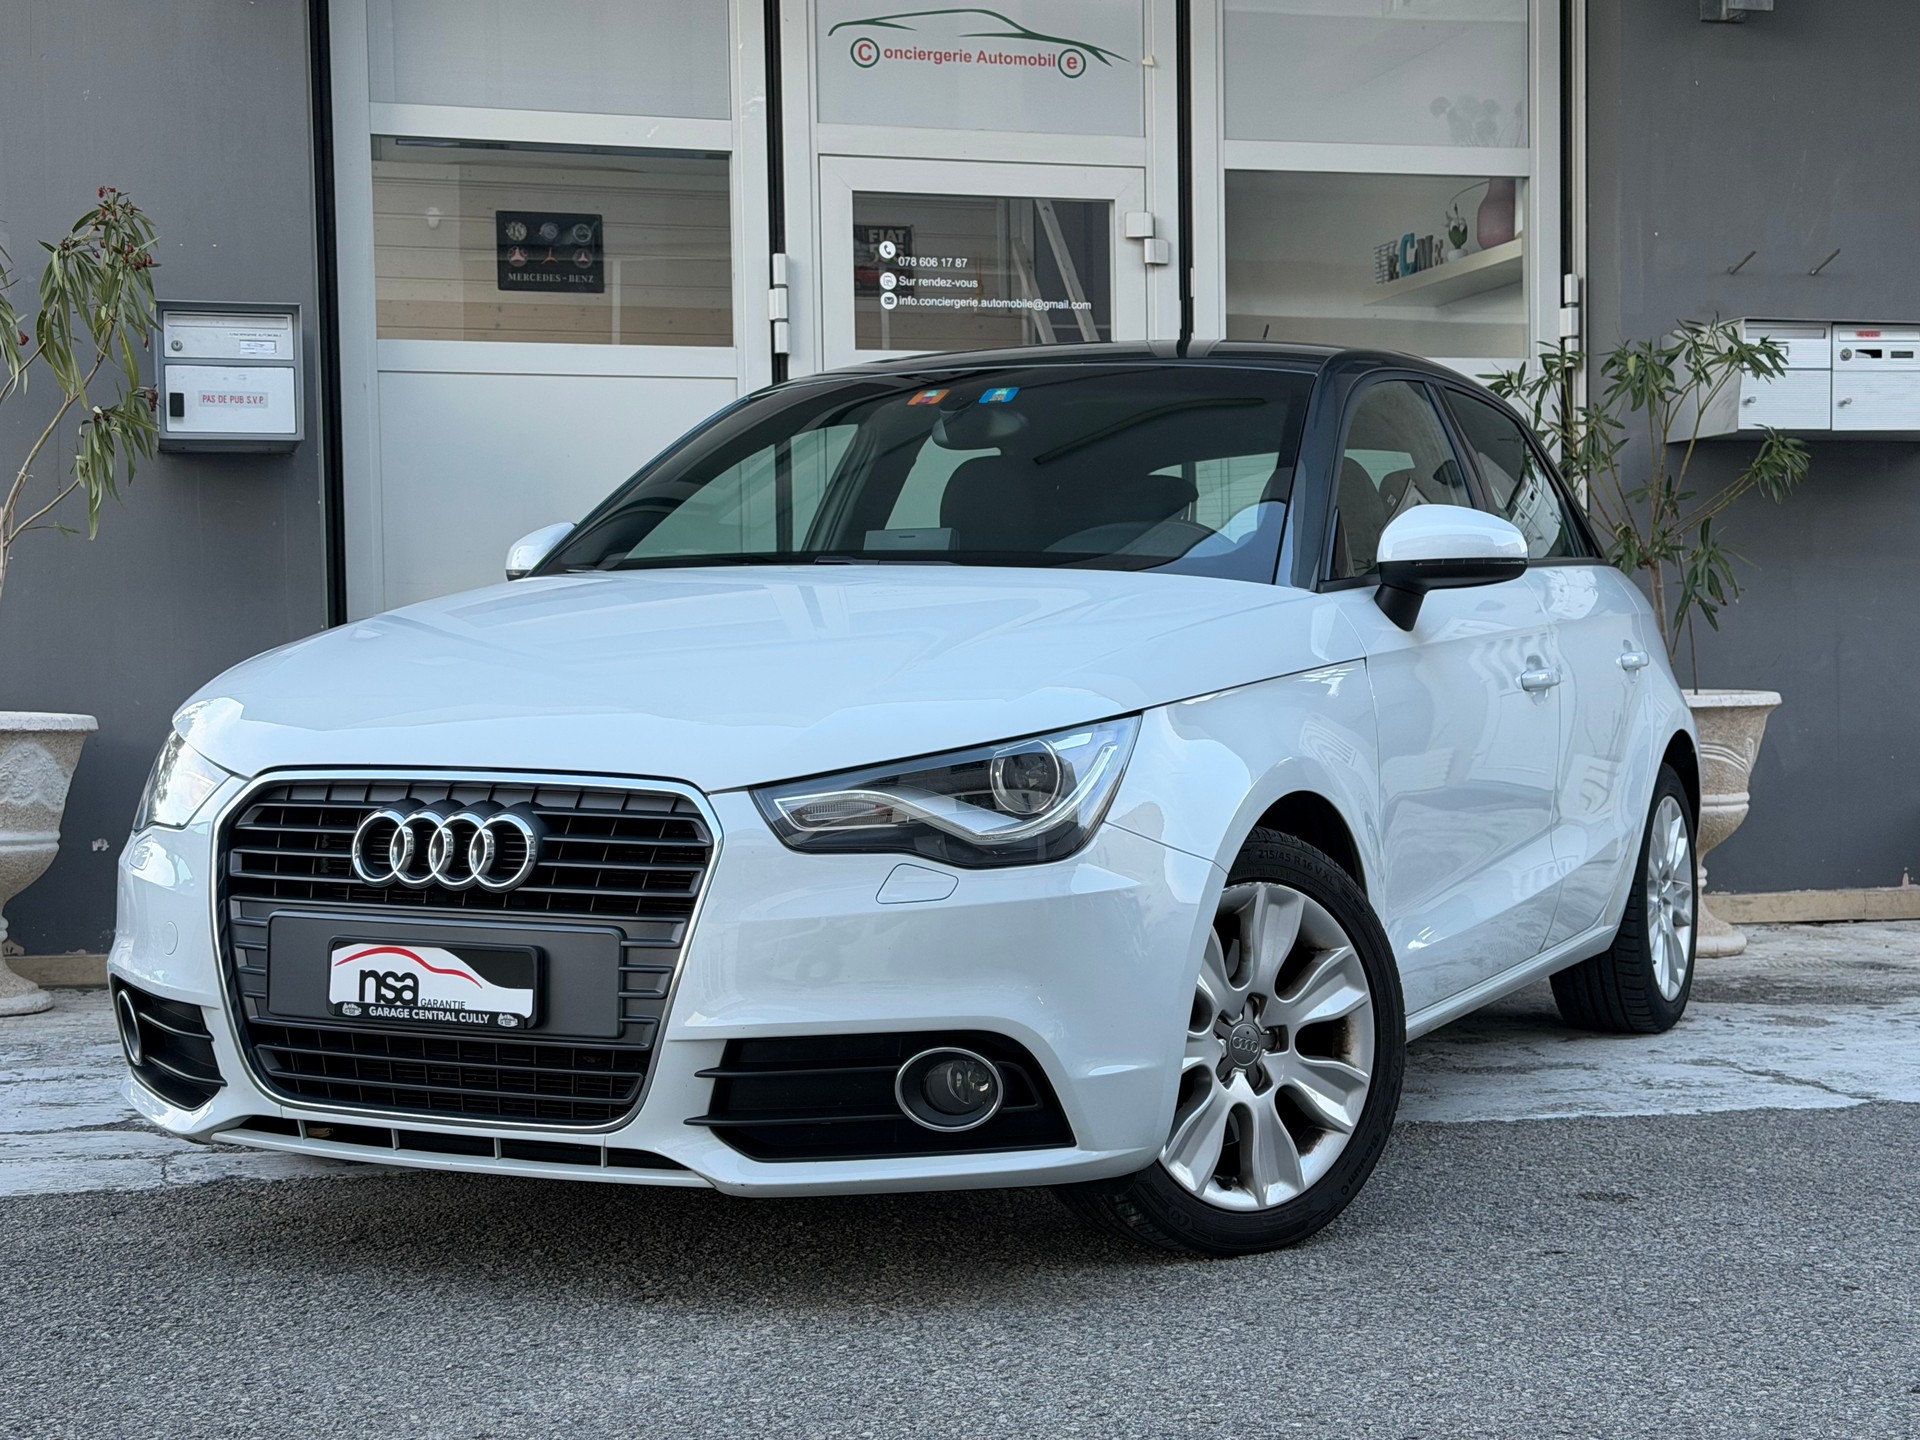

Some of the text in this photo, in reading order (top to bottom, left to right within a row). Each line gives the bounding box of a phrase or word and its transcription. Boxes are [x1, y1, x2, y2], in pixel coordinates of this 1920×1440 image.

[868, 229, 905, 243] FIAT
[898, 256, 968, 268] 078 606 17 87
[898, 275, 979, 289] Sur rendez-vous
[898, 296, 1092, 311] info.conciergerie.automobile@gmail.com
[202, 394, 216, 404] PAS
[218, 395, 228, 404] DE
[229, 395, 245, 404] PUB
[359, 969, 466, 1010] nsa GARANTIE
[369, 1006, 410, 1019] GARAGE
[412, 1009, 458, 1022] CENTRAL
[459, 1012, 490, 1024] CULLY
